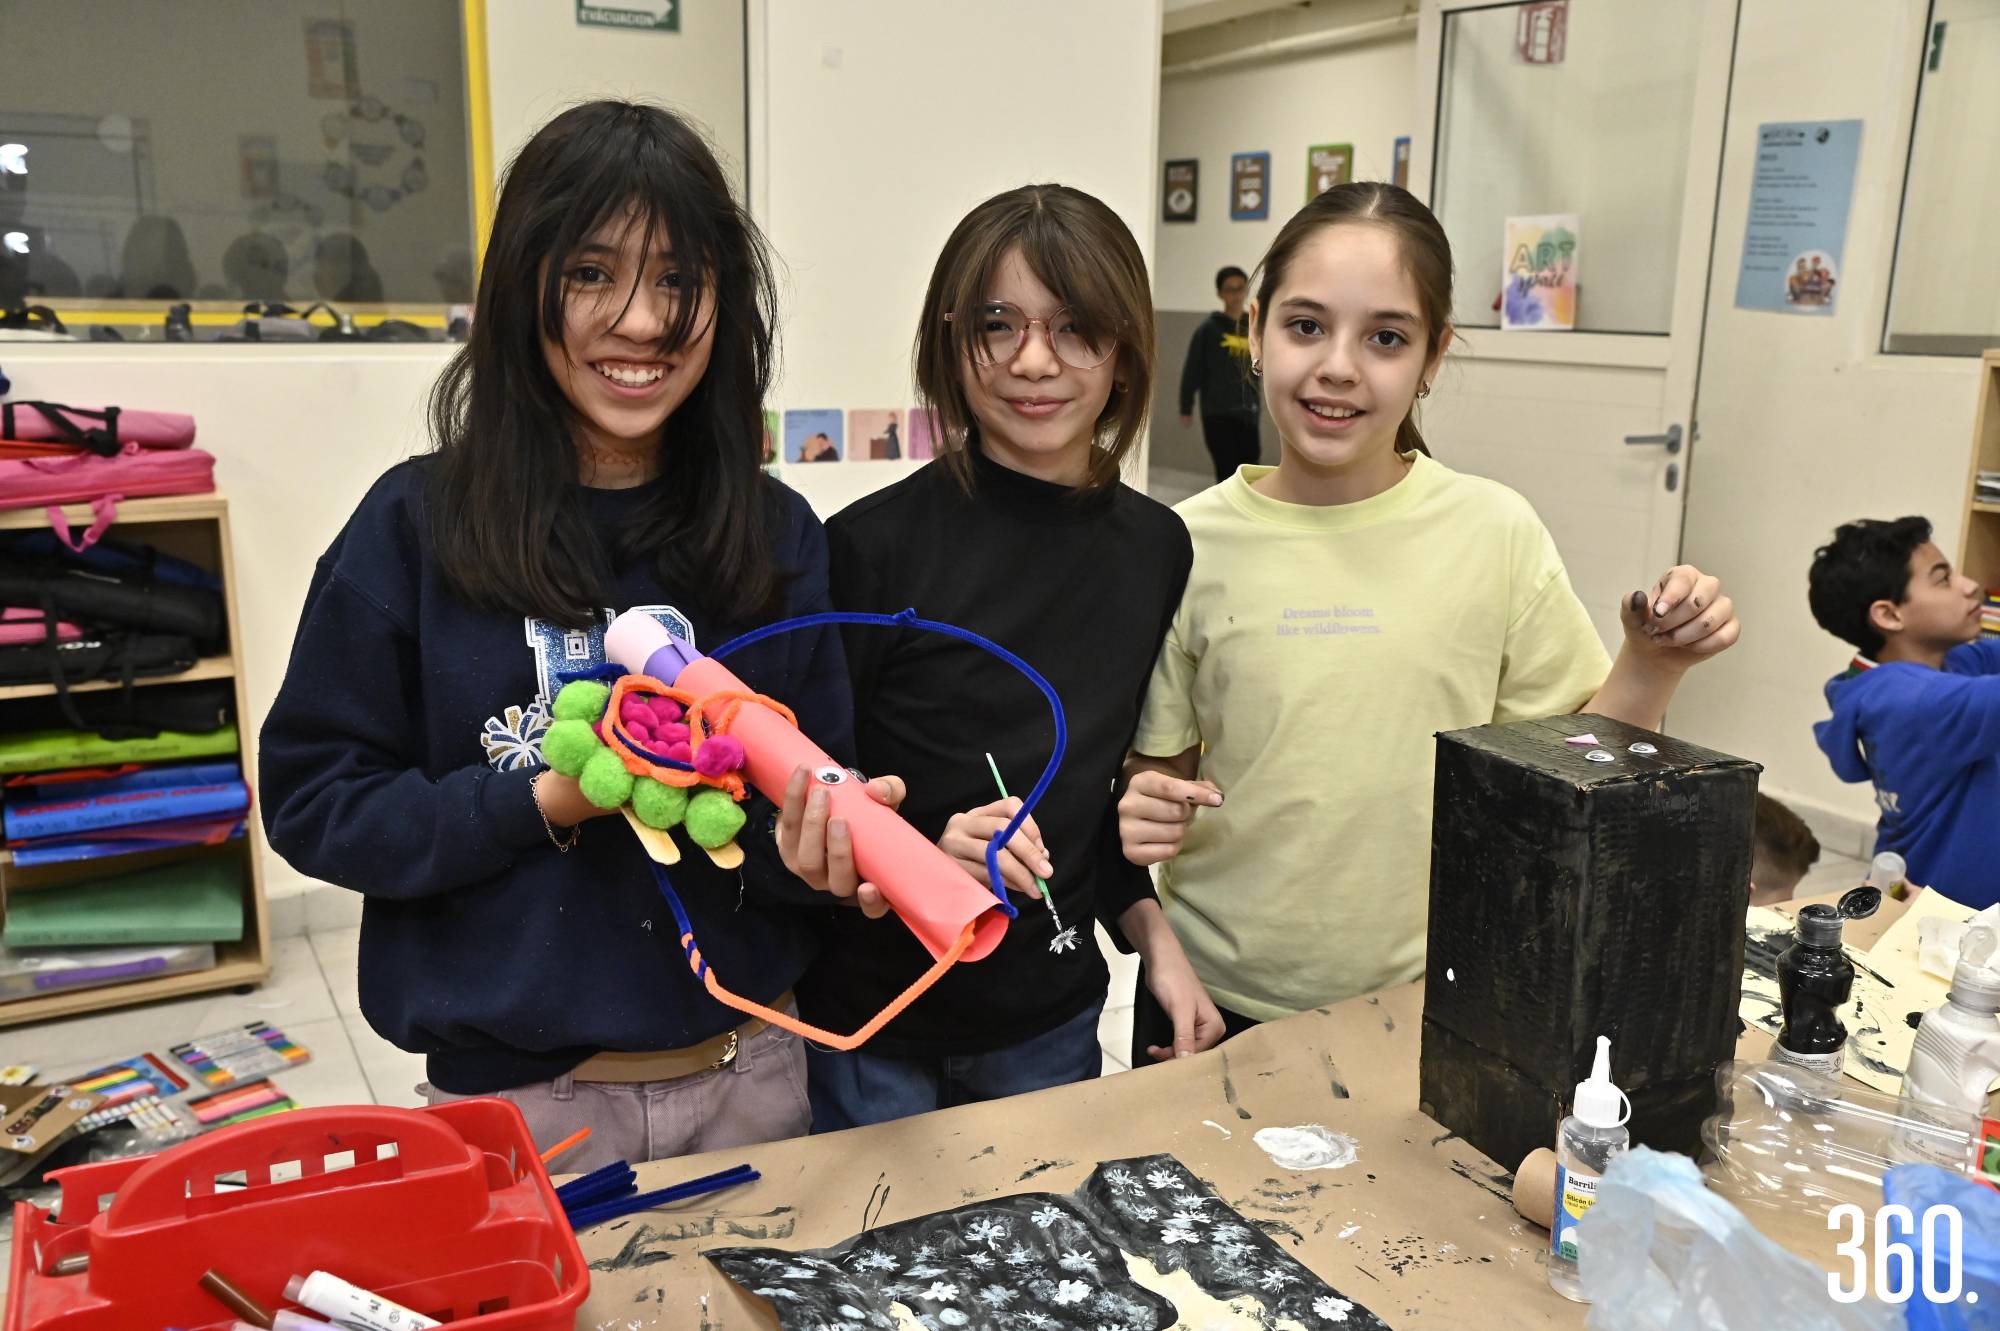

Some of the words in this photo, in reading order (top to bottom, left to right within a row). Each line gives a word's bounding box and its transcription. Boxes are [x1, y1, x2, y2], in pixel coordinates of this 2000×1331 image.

[1509, 239, 1576, 273] ART
[1283, 607, 1330, 619] Dreams
[1334, 605, 1374, 618] bloom
[1276, 623, 1300, 635] like
